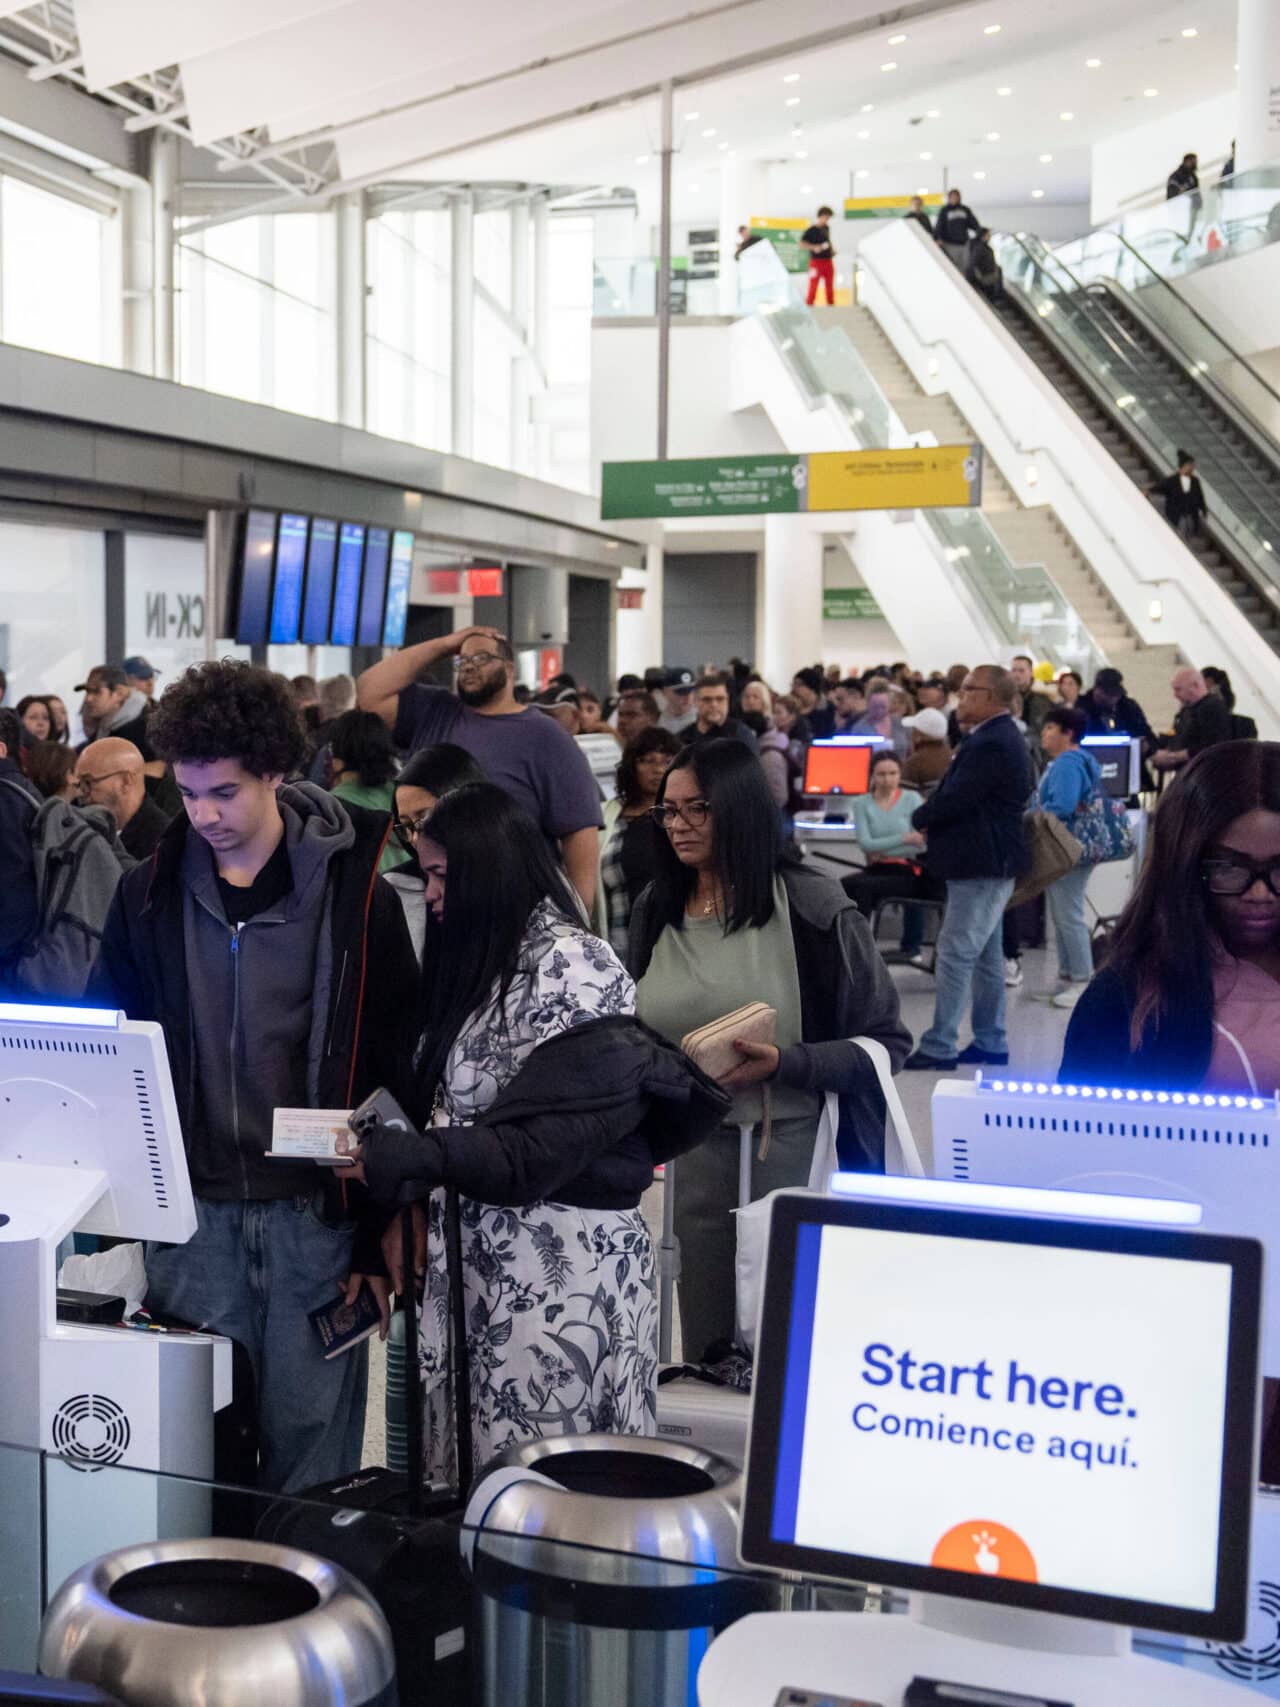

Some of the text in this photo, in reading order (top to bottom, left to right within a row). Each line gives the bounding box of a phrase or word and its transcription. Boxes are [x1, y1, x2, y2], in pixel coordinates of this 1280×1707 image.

[862, 1343, 1138, 1419] Start here.
[851, 1402, 1139, 1470] Comience aquí.
